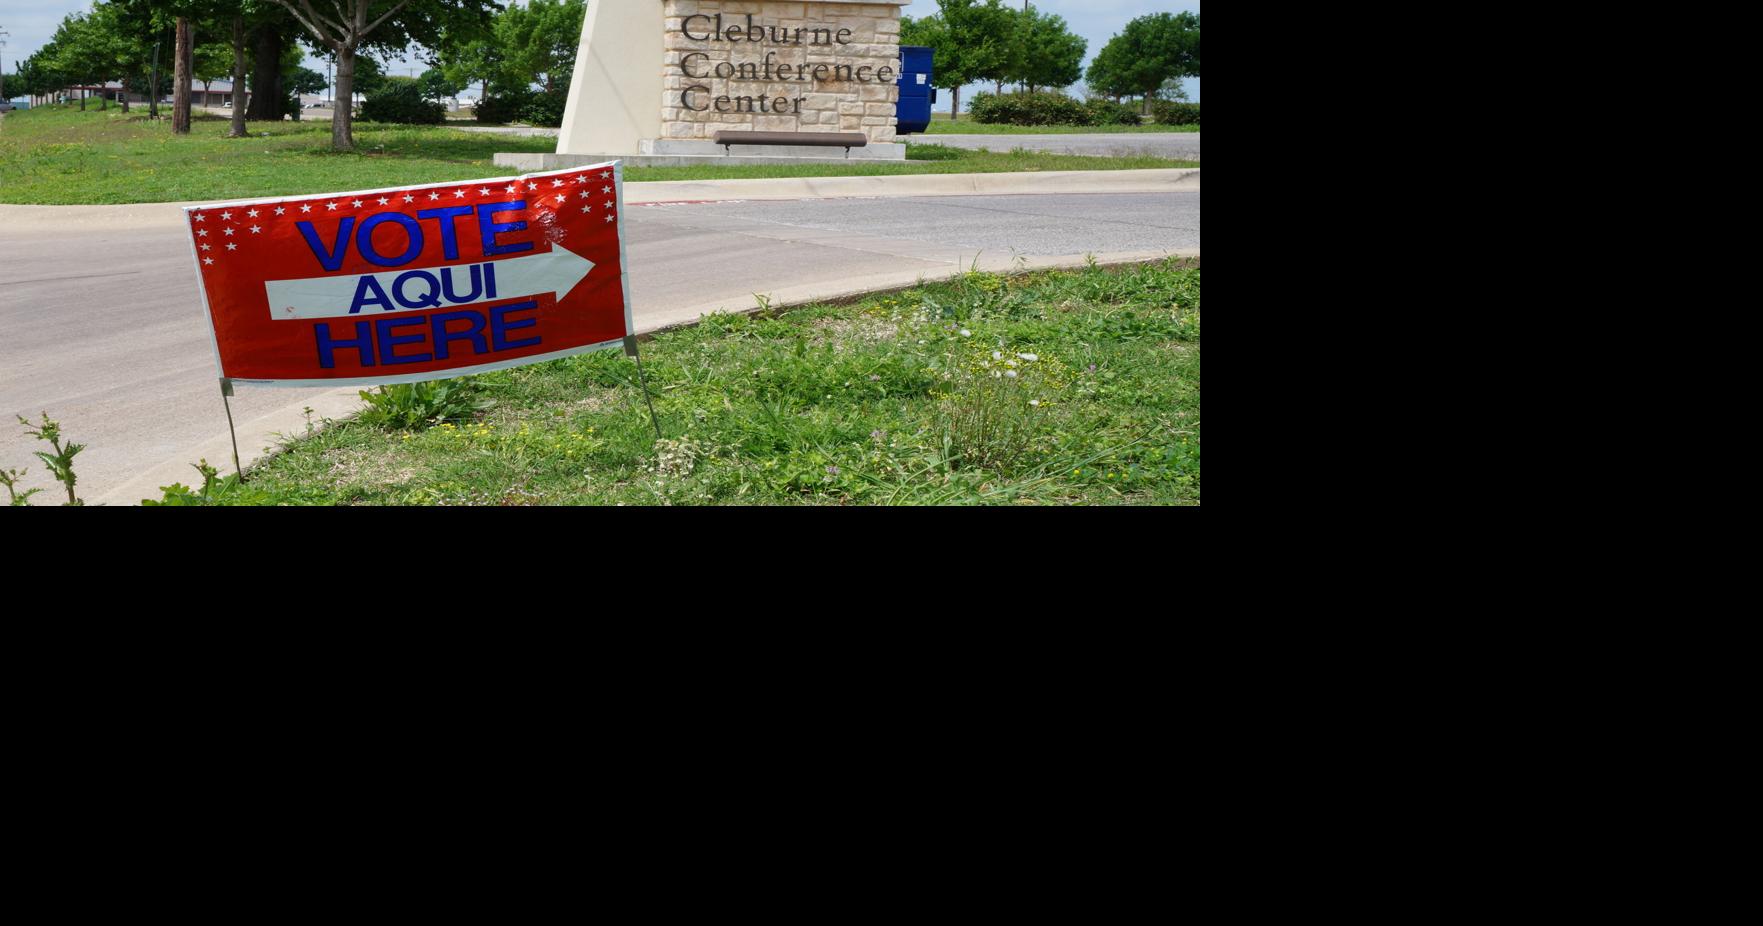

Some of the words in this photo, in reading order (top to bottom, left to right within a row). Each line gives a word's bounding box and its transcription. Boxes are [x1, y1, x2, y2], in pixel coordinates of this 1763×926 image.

[681, 13, 852, 45] Cleburne
[681, 52, 893, 82] Conference
[681, 85, 806, 114] Center
[295, 201, 534, 272] VOTE
[348, 262, 496, 314] AQUI
[314, 301, 541, 369] HERE
